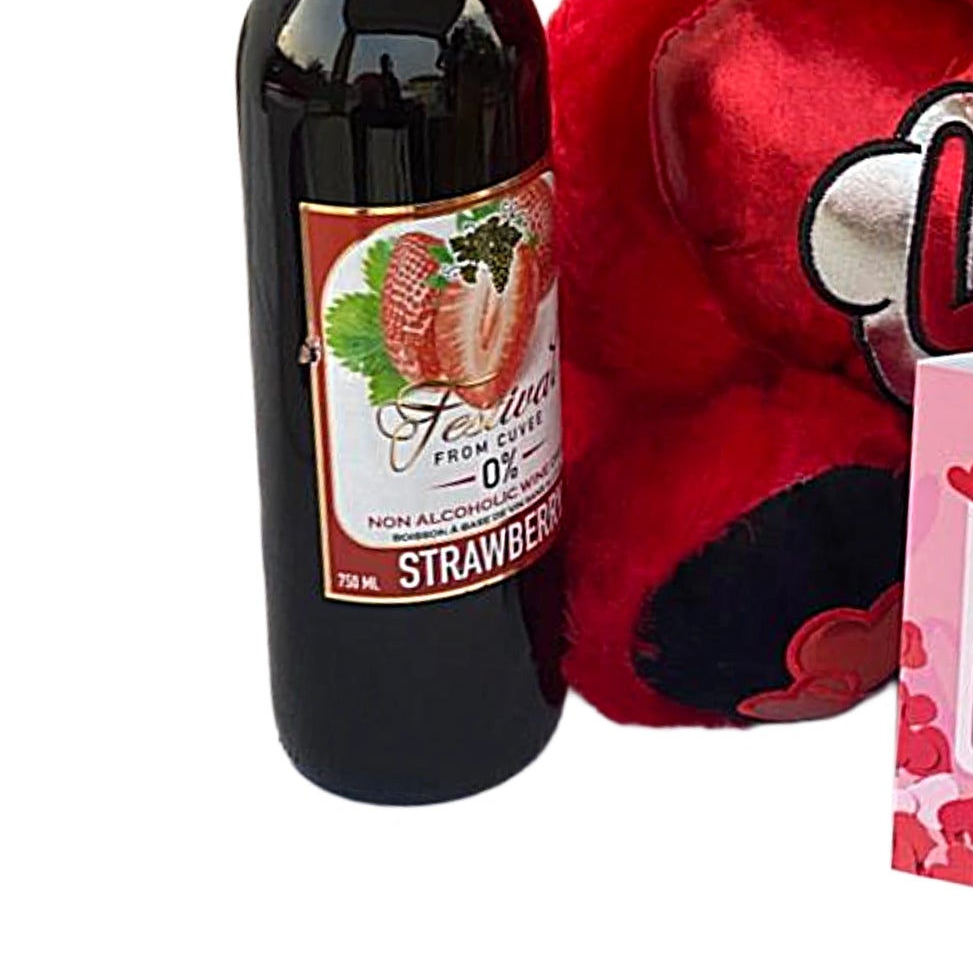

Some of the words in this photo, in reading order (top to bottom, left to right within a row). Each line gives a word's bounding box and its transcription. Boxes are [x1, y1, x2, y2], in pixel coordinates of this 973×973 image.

[434, 440, 488, 465] FROM
[482, 448, 518, 489] 0%
[368, 516, 411, 529] NON
[416, 486, 517, 527] ALCOHOLIC
[361, 575, 381, 591] ML
